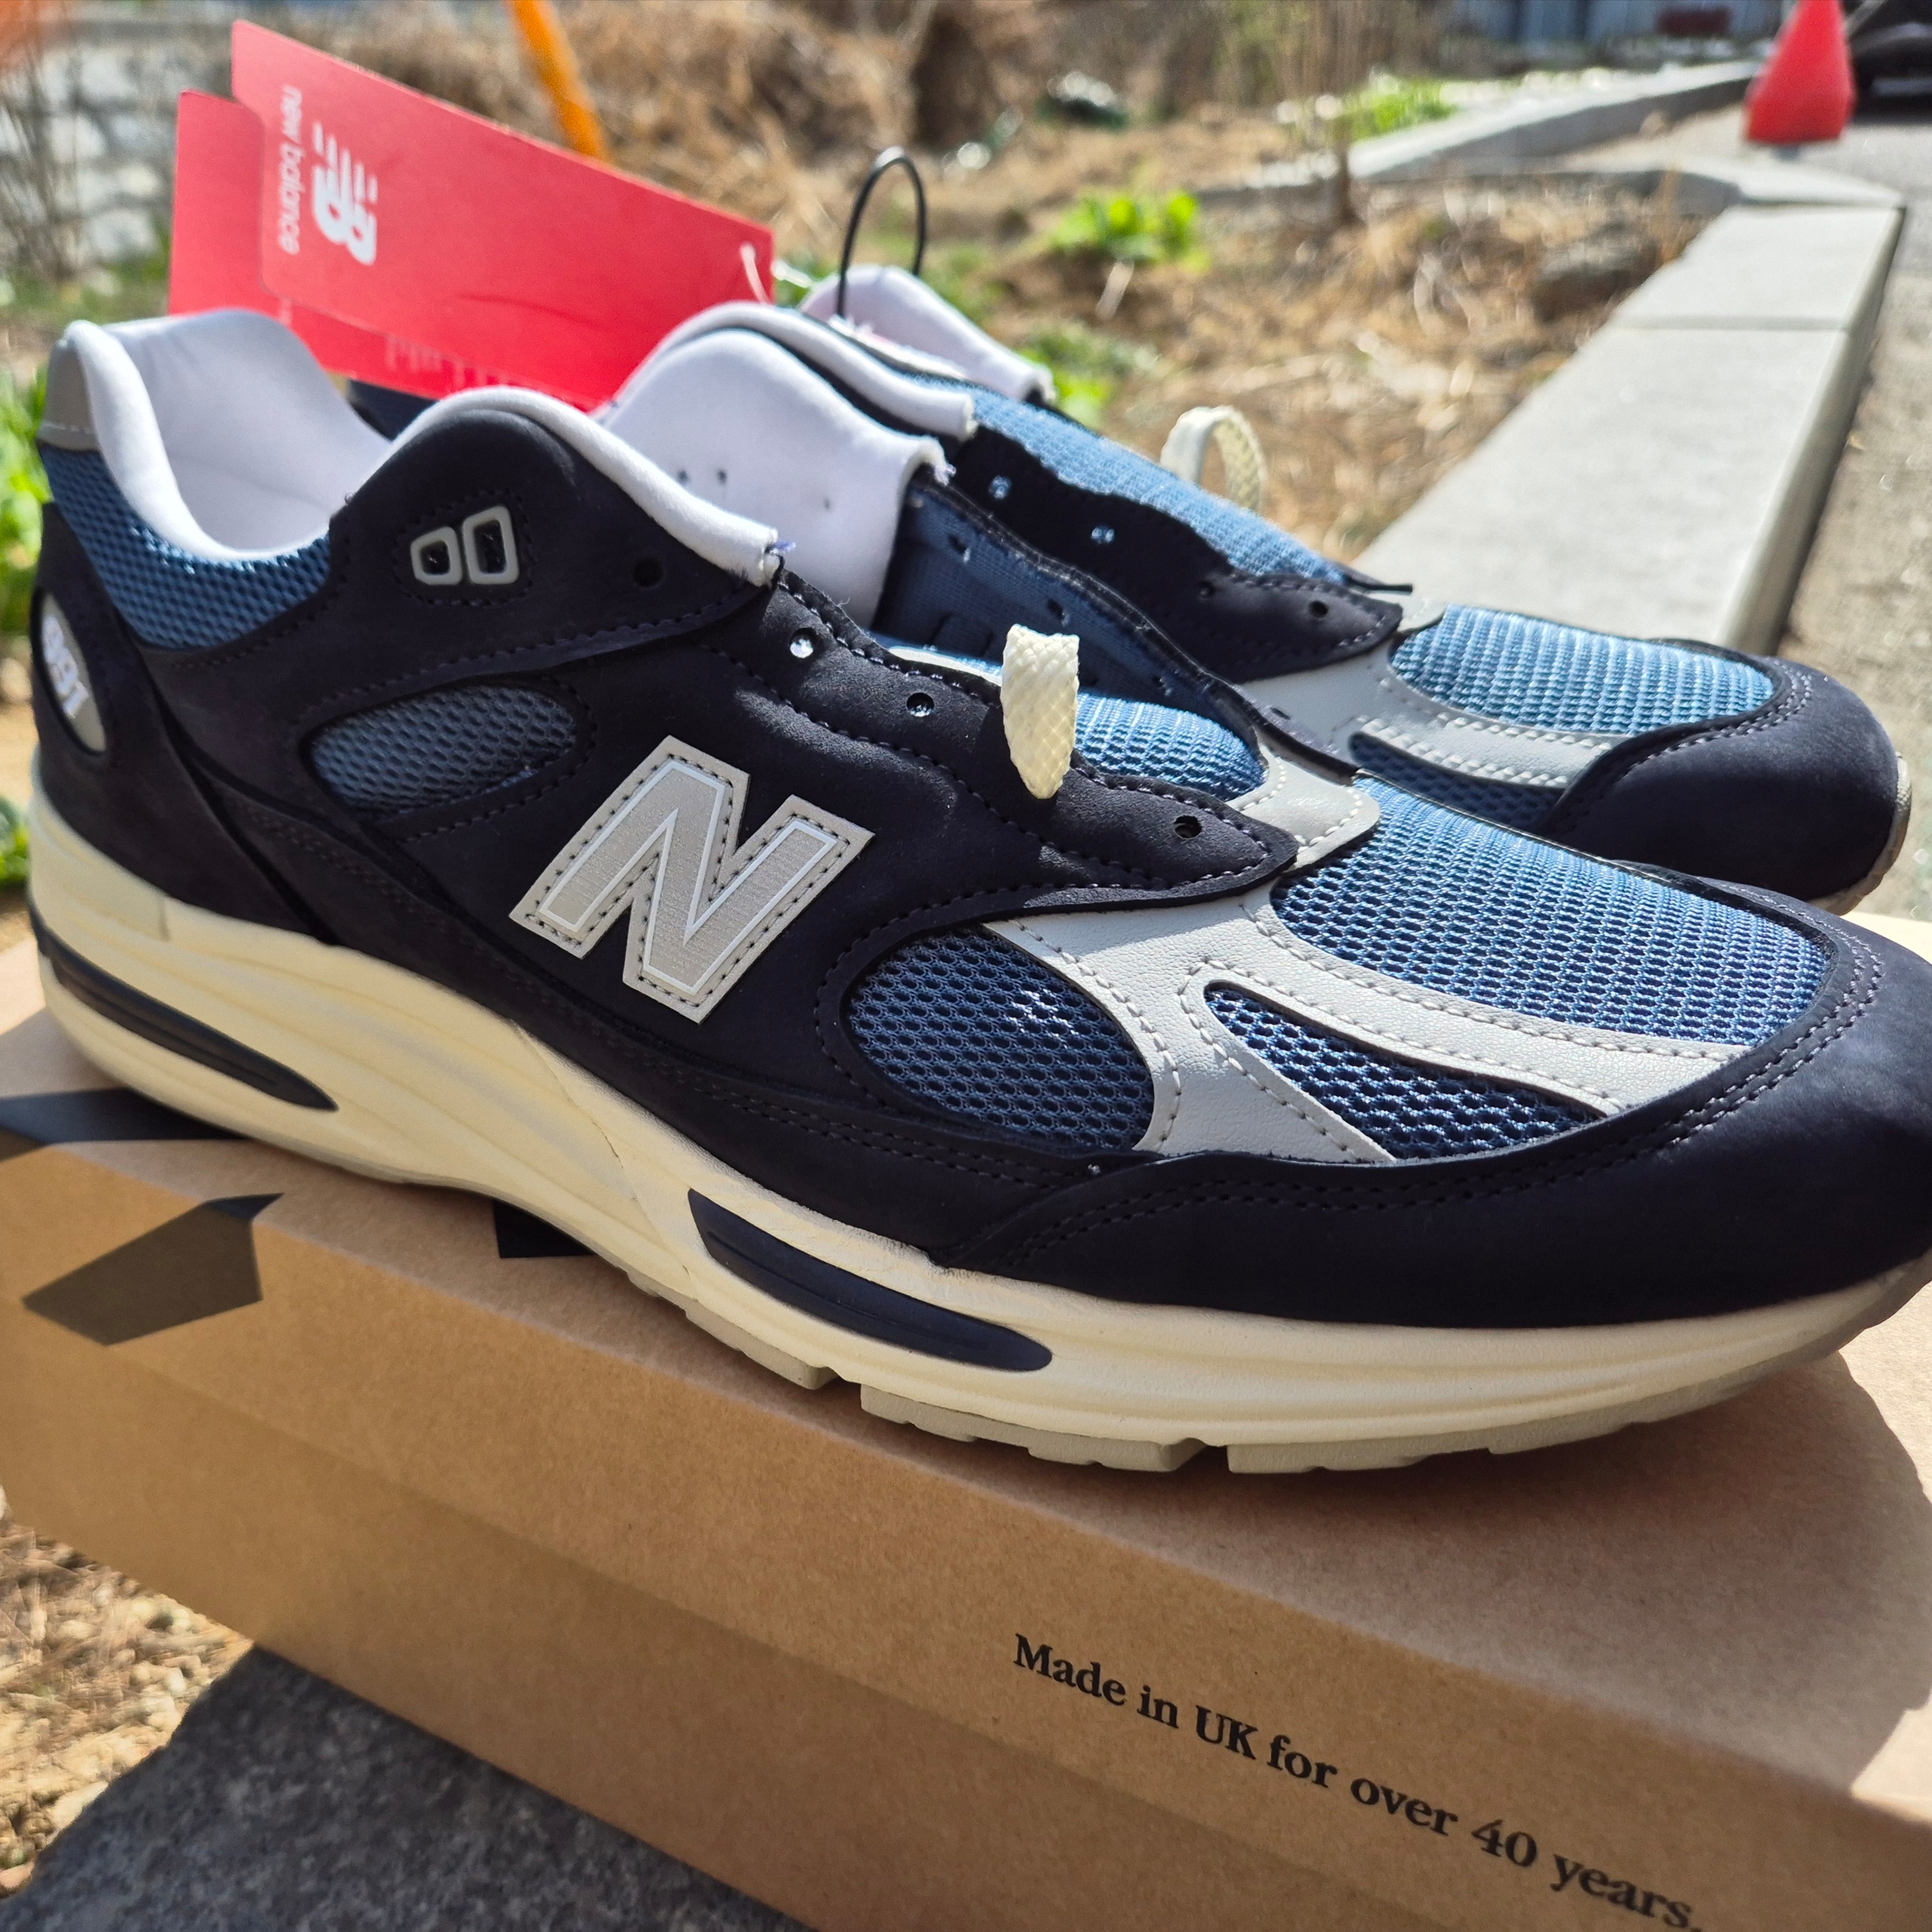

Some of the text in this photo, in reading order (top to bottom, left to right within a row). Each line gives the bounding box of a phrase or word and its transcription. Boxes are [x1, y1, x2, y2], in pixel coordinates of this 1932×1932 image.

[278, 84, 306, 255] new balance
[509, 735, 876, 1024] N
[1013, 1633, 1127, 1705] Made
[1137, 1684, 1179, 1728] in
[1195, 1705, 1258, 1760] UK
[1266, 1734, 1338, 1788] for
[1350, 1778, 1458, 1836] over
[1472, 1819, 1537, 1868] 40
